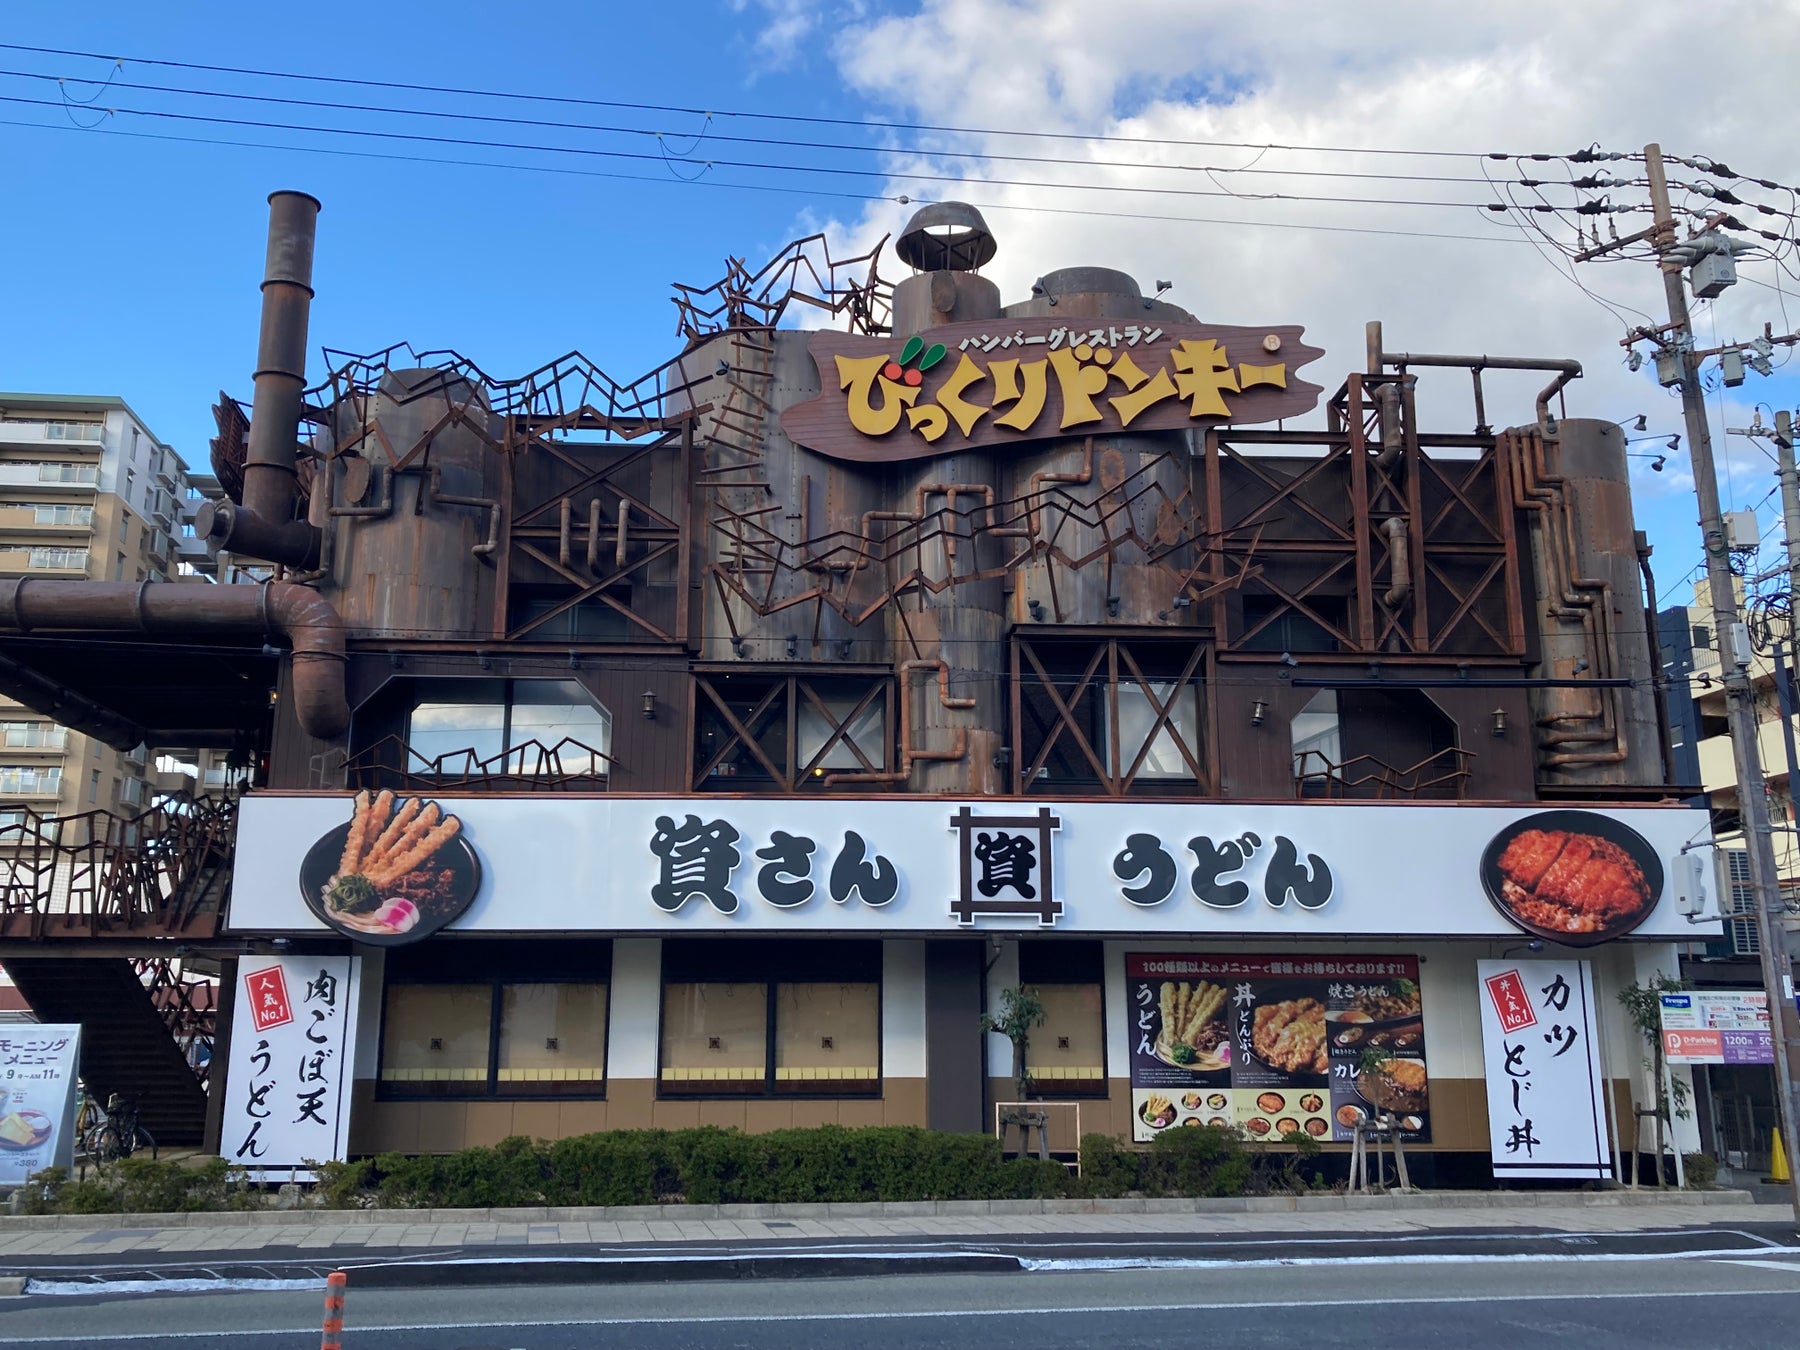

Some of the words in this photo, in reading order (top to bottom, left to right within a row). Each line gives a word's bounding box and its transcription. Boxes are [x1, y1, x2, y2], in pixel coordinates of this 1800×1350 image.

[958, 326, 1163, 352] ハンバーグレストラン
[834, 338, 1286, 443] びっくりドンキー
[650, 814, 901, 915] 資さん
[975, 831, 1036, 900] 資
[1113, 831, 1335, 910] うどん
[1136, 983, 1157, 1056] うどん
[1232, 982, 1257, 1007] 丼
[1328, 982, 1390, 999] 焼きうどん
[1541, 974, 1578, 1058] カツ
[0, 1038, 69, 1052] モーニング
[4, 1054, 58, 1065] メニュー
[292, 969, 338, 1126] 肉ごぼ天
[1239, 1010, 1253, 1066] どんぶり
[236, 1039, 277, 1159] うどん
[1503, 1038, 1541, 1159] とじ丼
